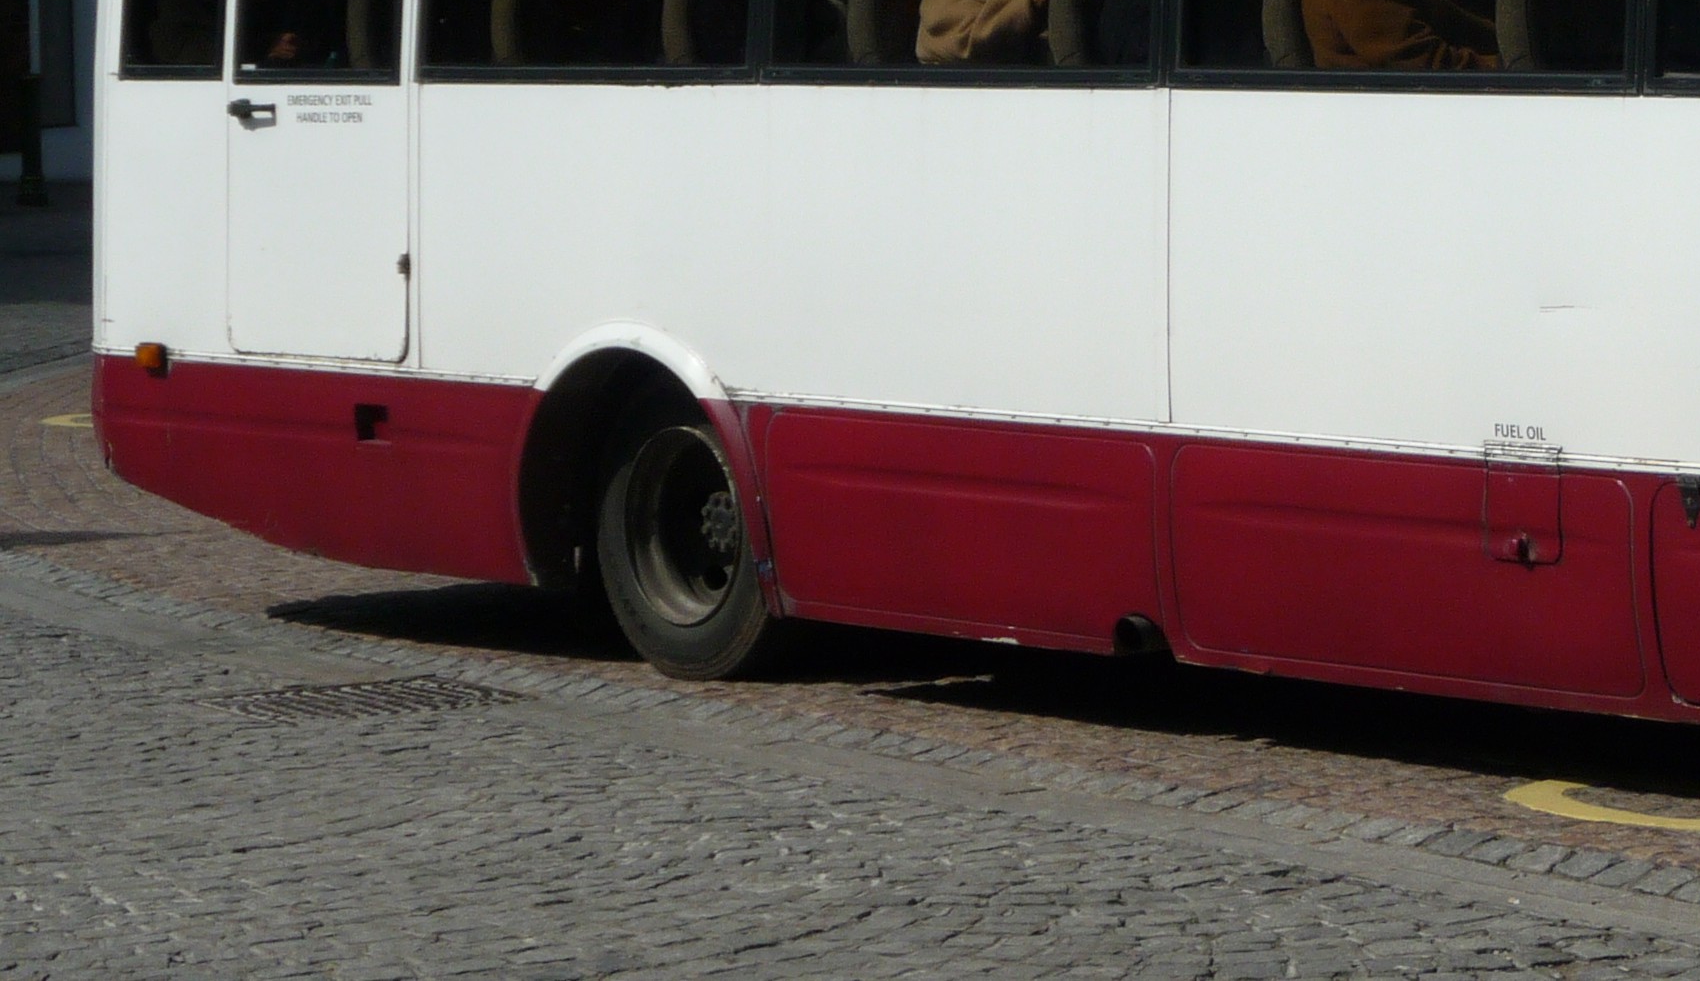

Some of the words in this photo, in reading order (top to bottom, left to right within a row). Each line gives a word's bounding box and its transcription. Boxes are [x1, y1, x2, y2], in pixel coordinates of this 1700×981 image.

[287, 95, 332, 106] EMERGENCY
[335, 95, 351, 106] EXIT
[354, 95, 372, 106] PULL
[296, 112, 328, 123] HANDLE
[329, 112, 340, 123] TO
[341, 112, 363, 123] OPEN
[1494, 423, 1524, 439] FUEL
[1526, 426, 1547, 441] OIL
